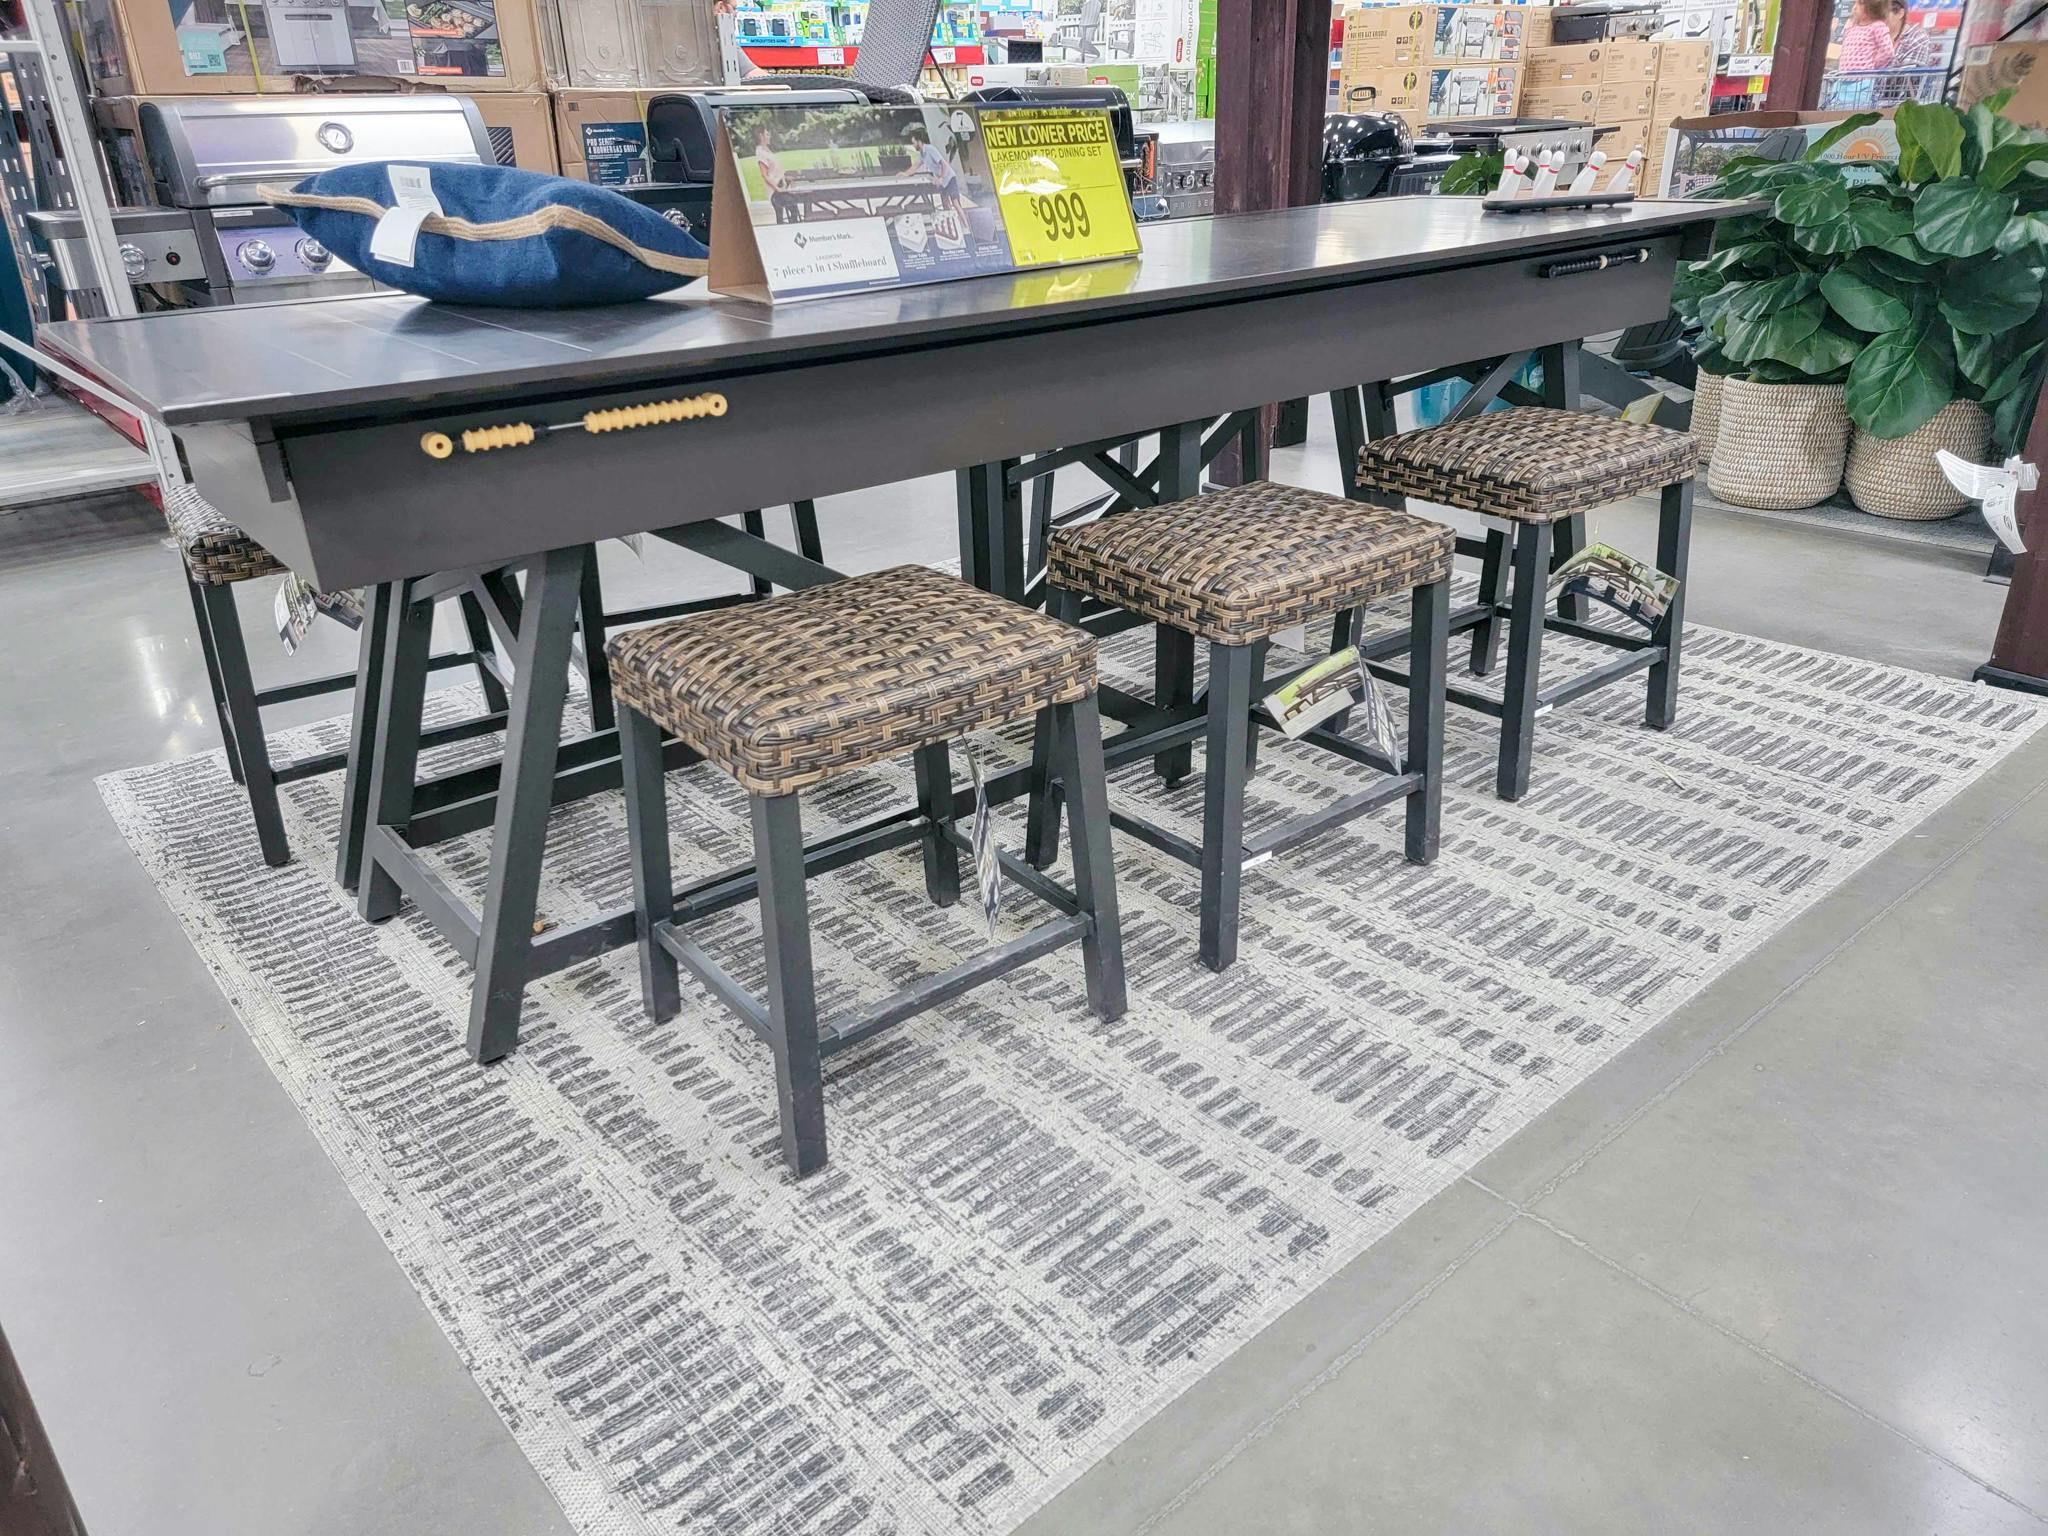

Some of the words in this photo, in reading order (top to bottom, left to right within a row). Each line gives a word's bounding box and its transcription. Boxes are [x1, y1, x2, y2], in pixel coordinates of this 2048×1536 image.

[984, 126, 1017, 147] NEW
[1019, 123, 1068, 145] LOWER
[1068, 119, 1106, 143] PRICE
[990, 149, 1039, 163] LAKEMONT
[1058, 147, 1086, 158] DINING
[1087, 146, 1102, 157] SET
[809, 234, 836, 243] Member's
[773, 268, 779, 277] 7
[782, 264, 806, 278] piece
[815, 262, 825, 273] in
[833, 256, 887, 271] Shuffleboard
